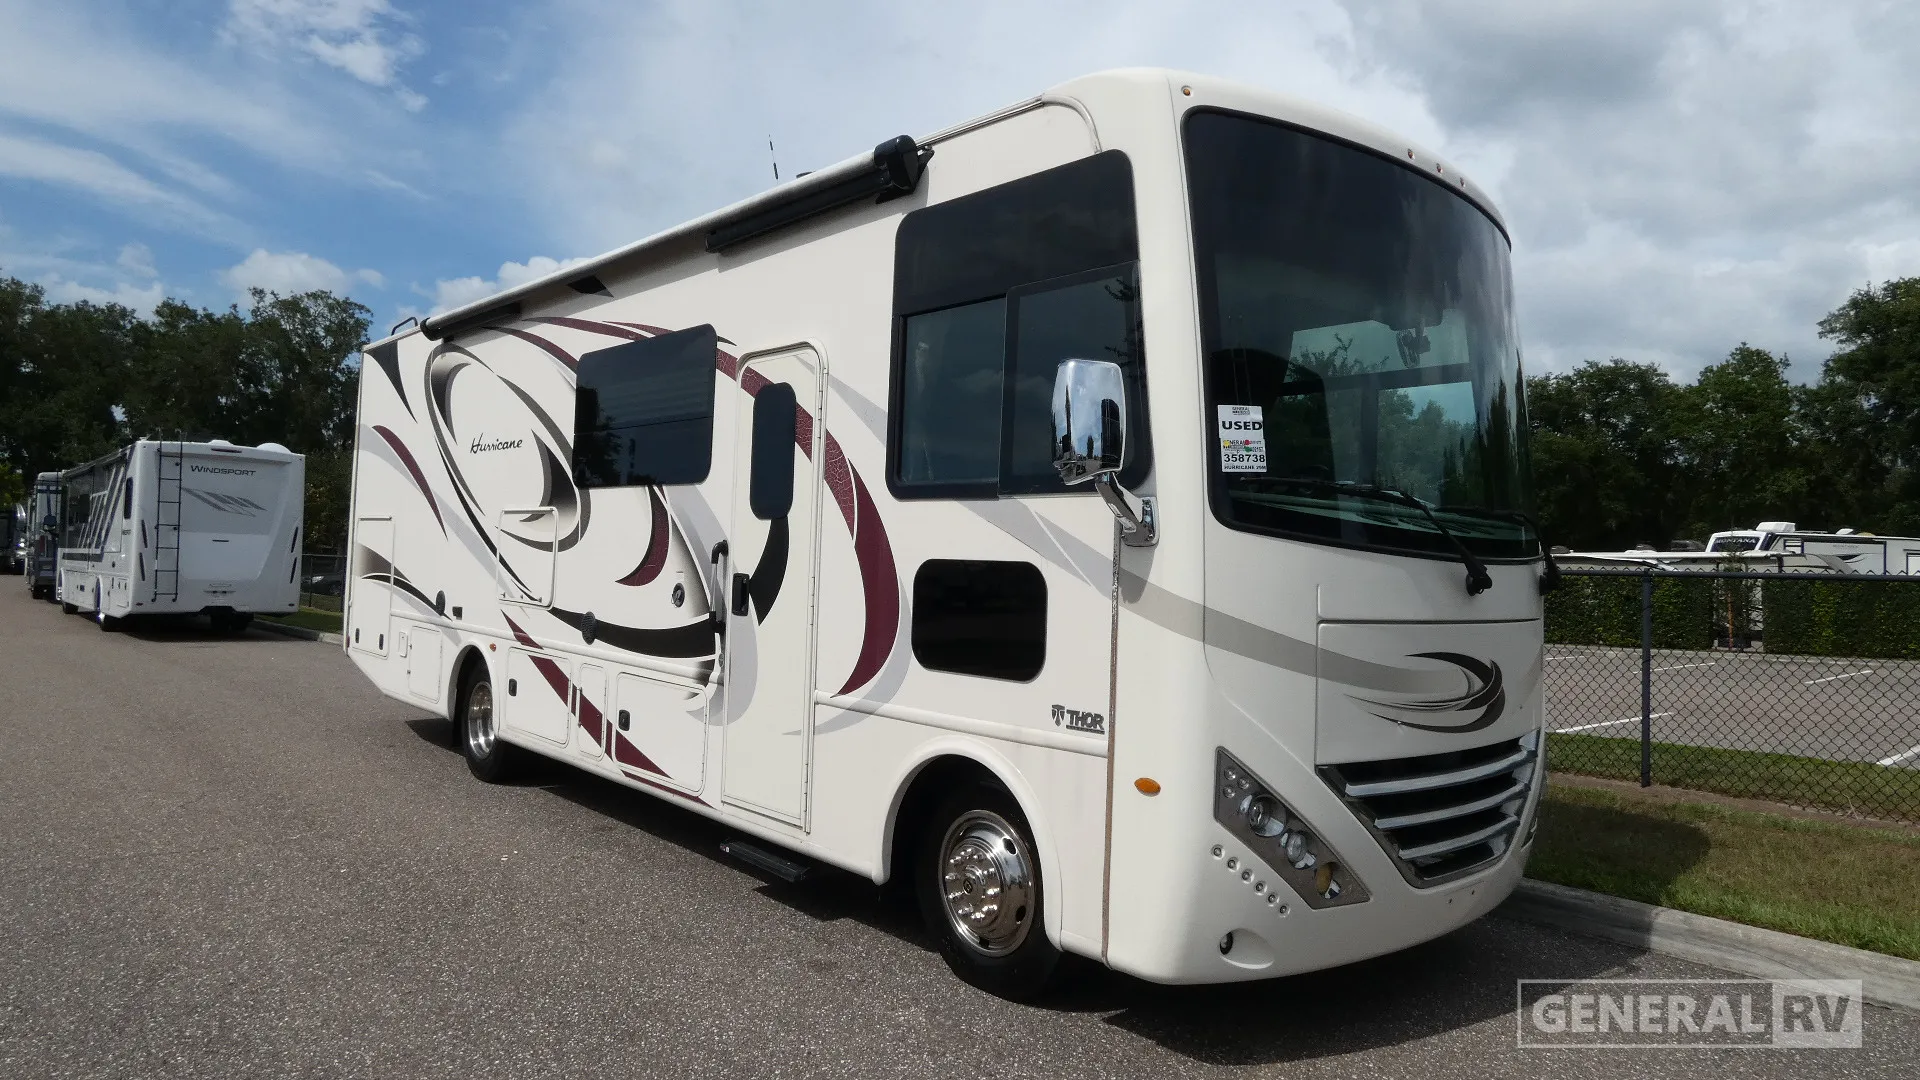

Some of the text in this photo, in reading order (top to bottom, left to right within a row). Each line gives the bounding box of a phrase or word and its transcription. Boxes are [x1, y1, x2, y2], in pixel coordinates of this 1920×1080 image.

[1222, 420, 1263, 430] USED
[470, 432, 522, 454] Hurricane
[1224, 454, 1265, 462] 358738
[1066, 709, 1104, 730] THOR
